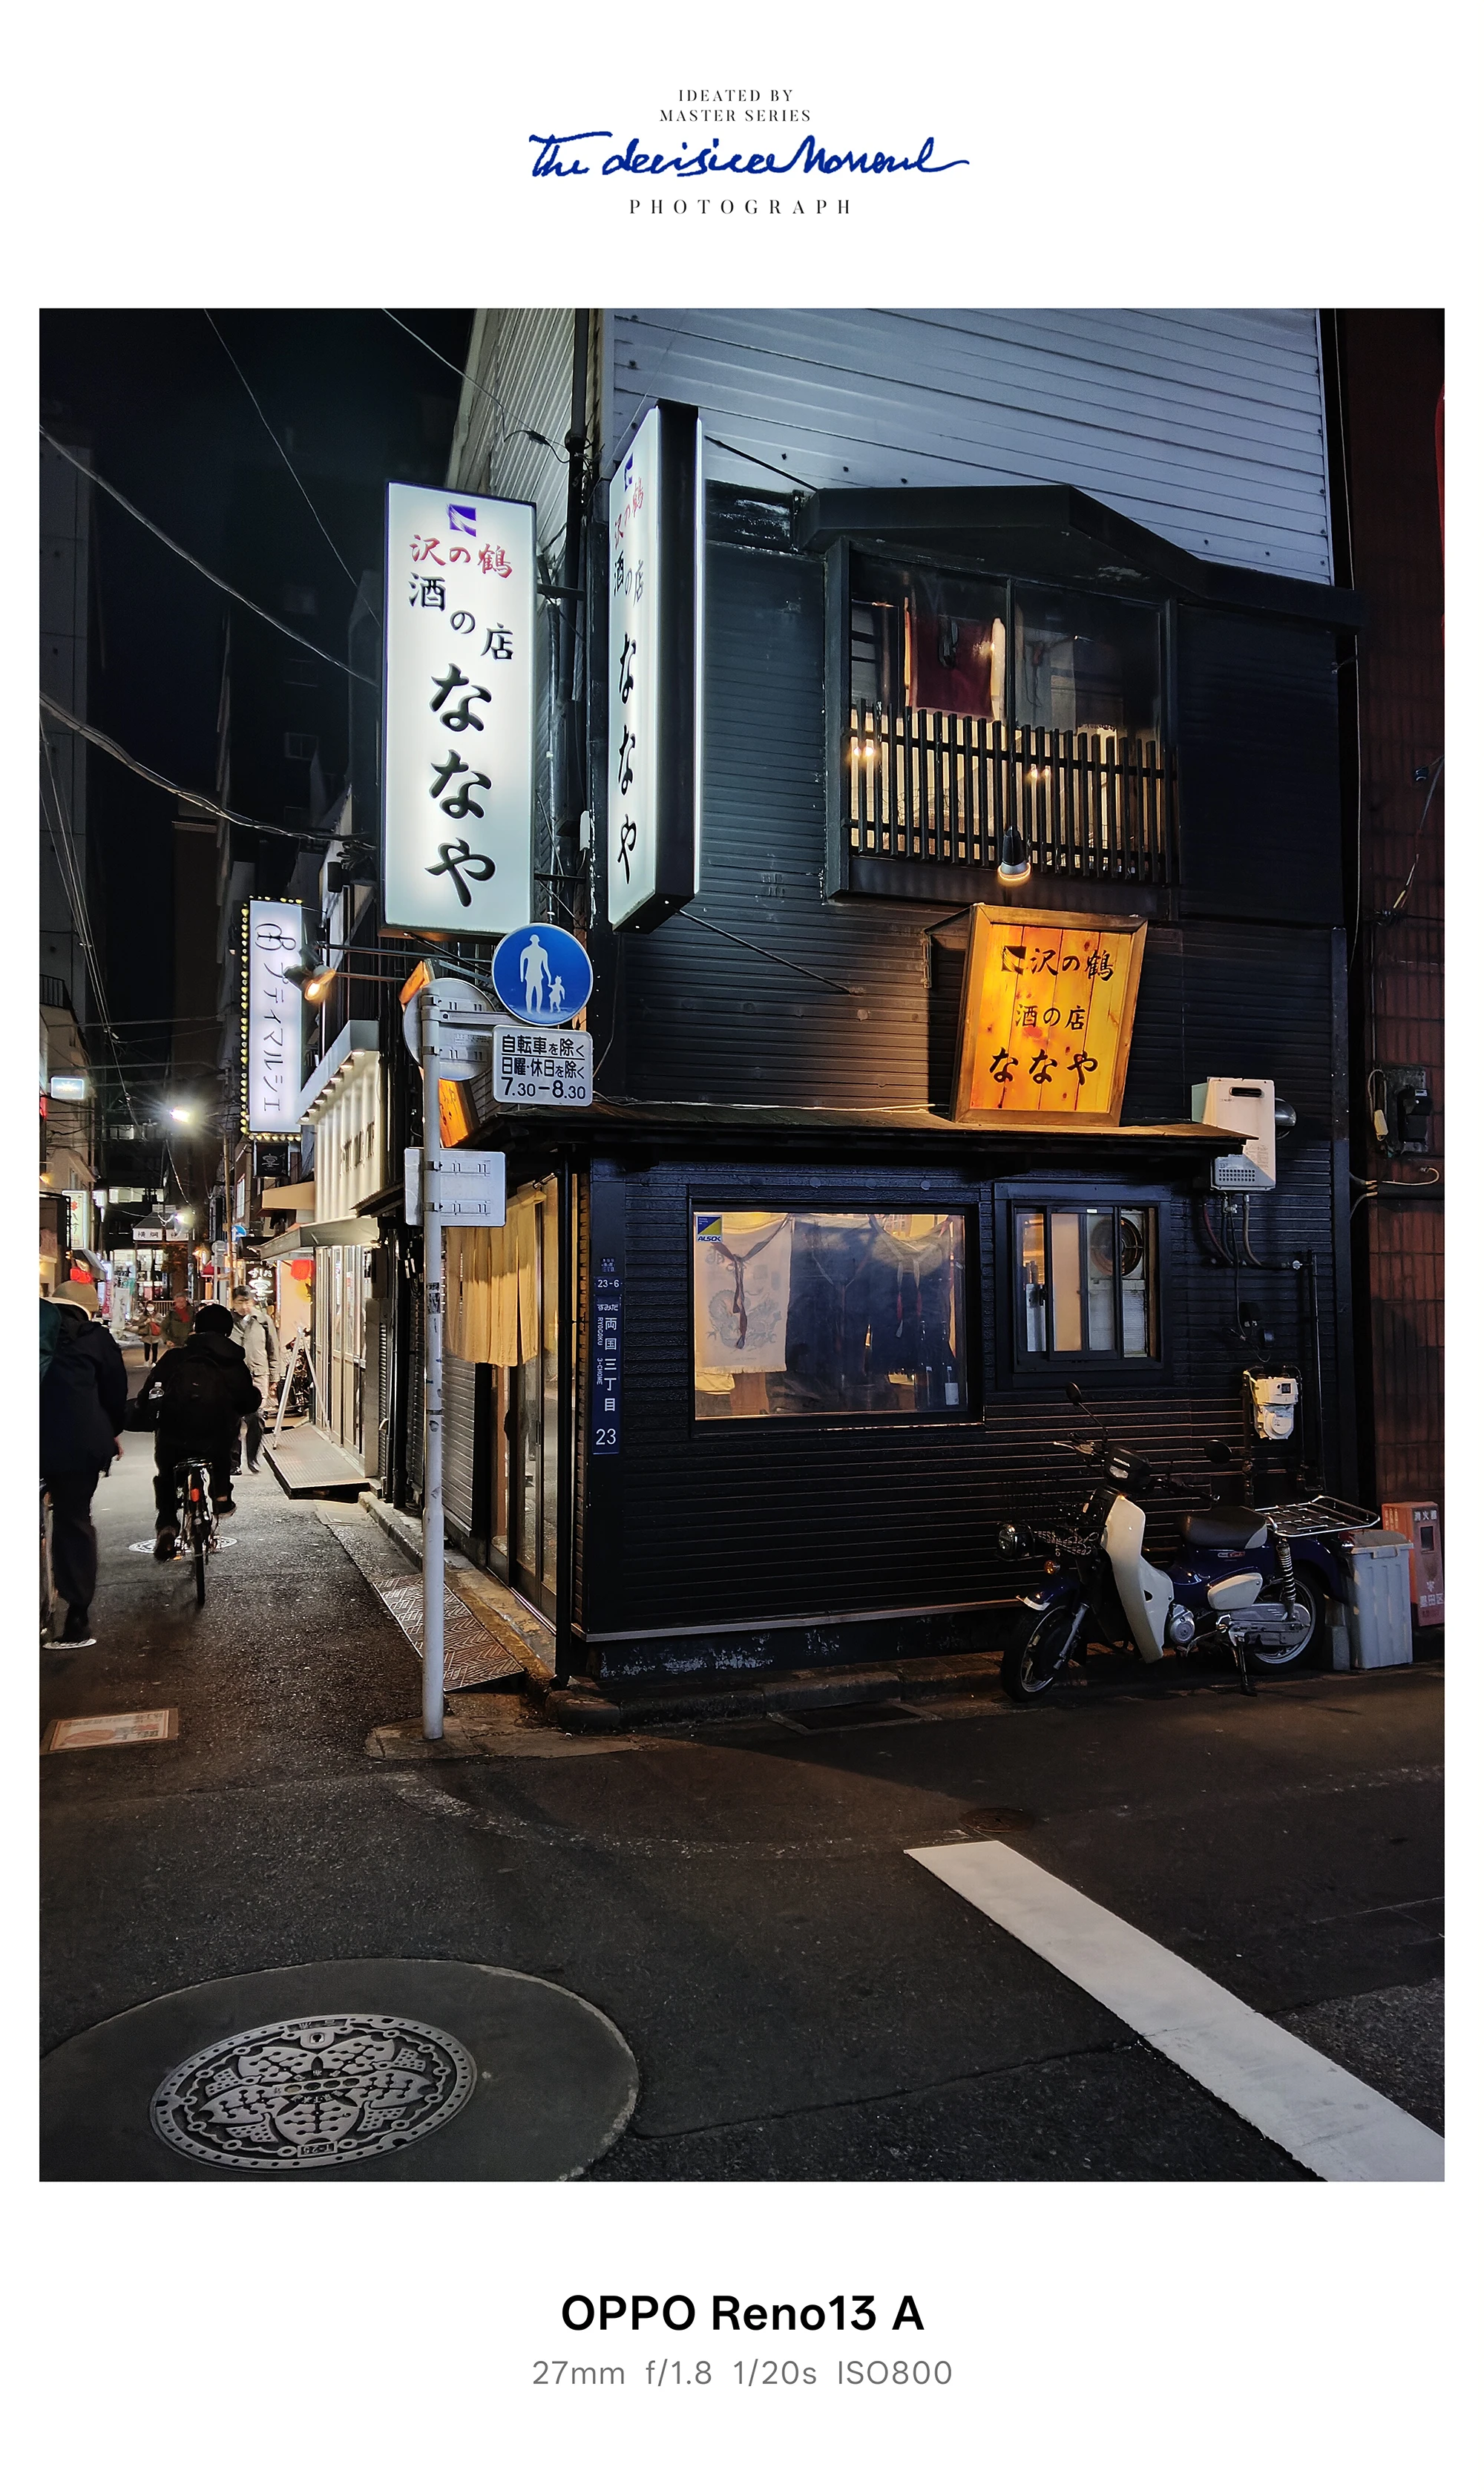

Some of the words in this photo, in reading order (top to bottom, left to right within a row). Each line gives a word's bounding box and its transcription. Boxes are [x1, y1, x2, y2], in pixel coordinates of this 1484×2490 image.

[614, 476, 644, 551] 沢の鶴
[410, 534, 513, 579] 沢の鶴
[614, 549, 644, 607] 酒の店
[408, 571, 513, 660] 酒の店
[617, 631, 637, 884] ななや
[424, 663, 496, 907] ななや
[1030, 947, 1114, 982] 沢の鶴
[1016, 1003, 1086, 1031] 酒の店
[502, 1034, 585, 1057] 自転車を除く
[989, 1048, 1098, 1085] ななや
[604, 1317, 617, 1411] 両国三丁目
[597, 1429, 616, 1445] 23
